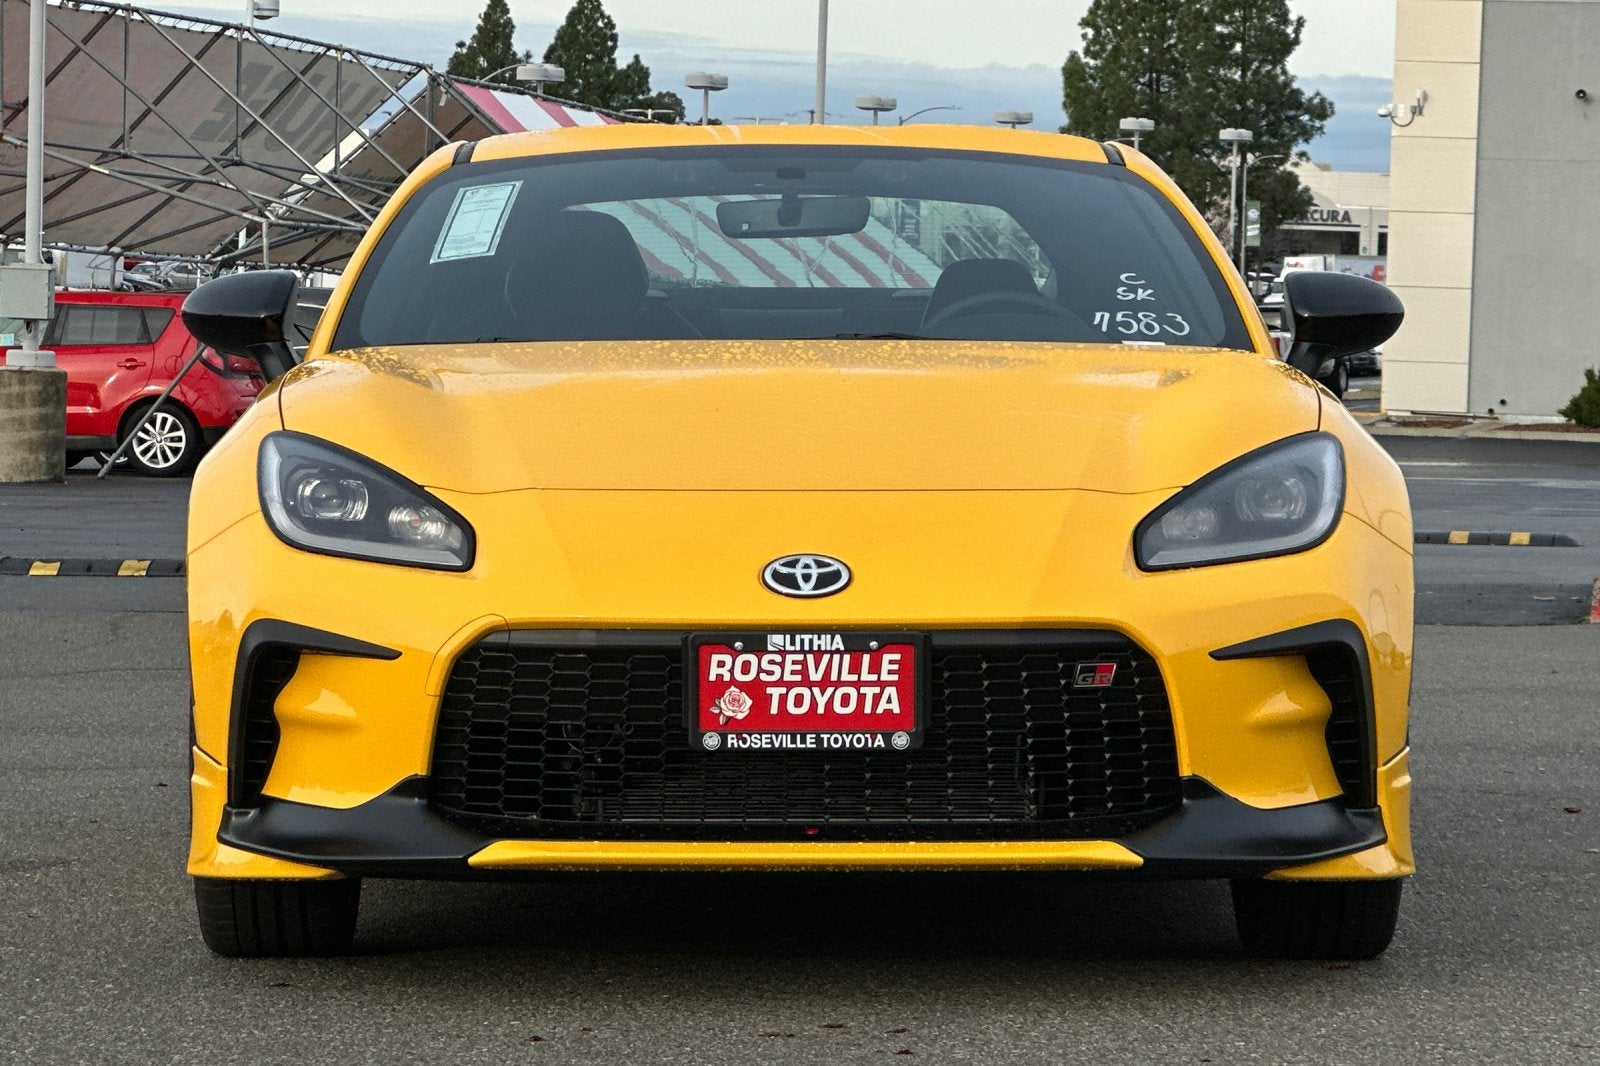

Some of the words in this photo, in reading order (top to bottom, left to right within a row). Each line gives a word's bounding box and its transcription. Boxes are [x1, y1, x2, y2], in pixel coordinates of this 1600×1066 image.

[785, 634, 845, 651] LITHIA
[708, 653, 902, 682] ROSEVILLE
[1077, 673, 1111, 685] GR
[765, 686, 901, 715] TOYOTA
[727, 733, 817, 749] ROSEVILLE
[820, 733, 885, 749] TOYOTA
